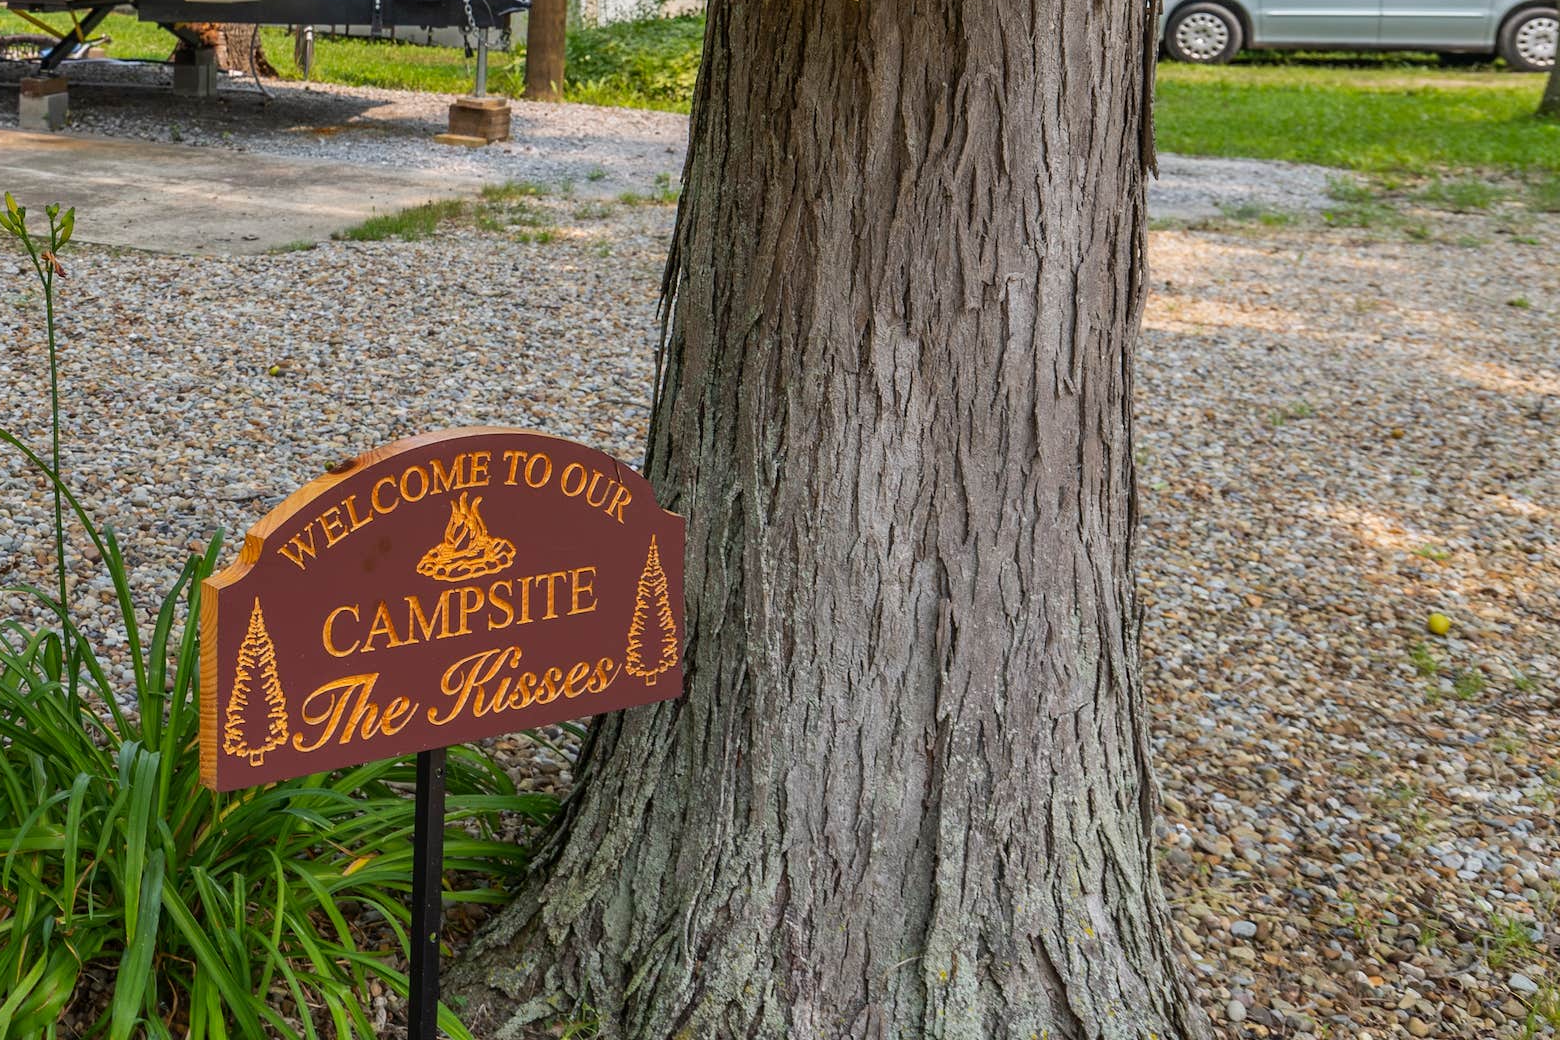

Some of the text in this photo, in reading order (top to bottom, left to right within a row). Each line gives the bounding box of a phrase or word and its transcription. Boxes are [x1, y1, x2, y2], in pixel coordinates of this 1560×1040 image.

[278, 449, 634, 571] WELCOME TO OUR
[321, 566, 599, 658] CAMPSITE
[292, 645, 622, 753] The Kisses
